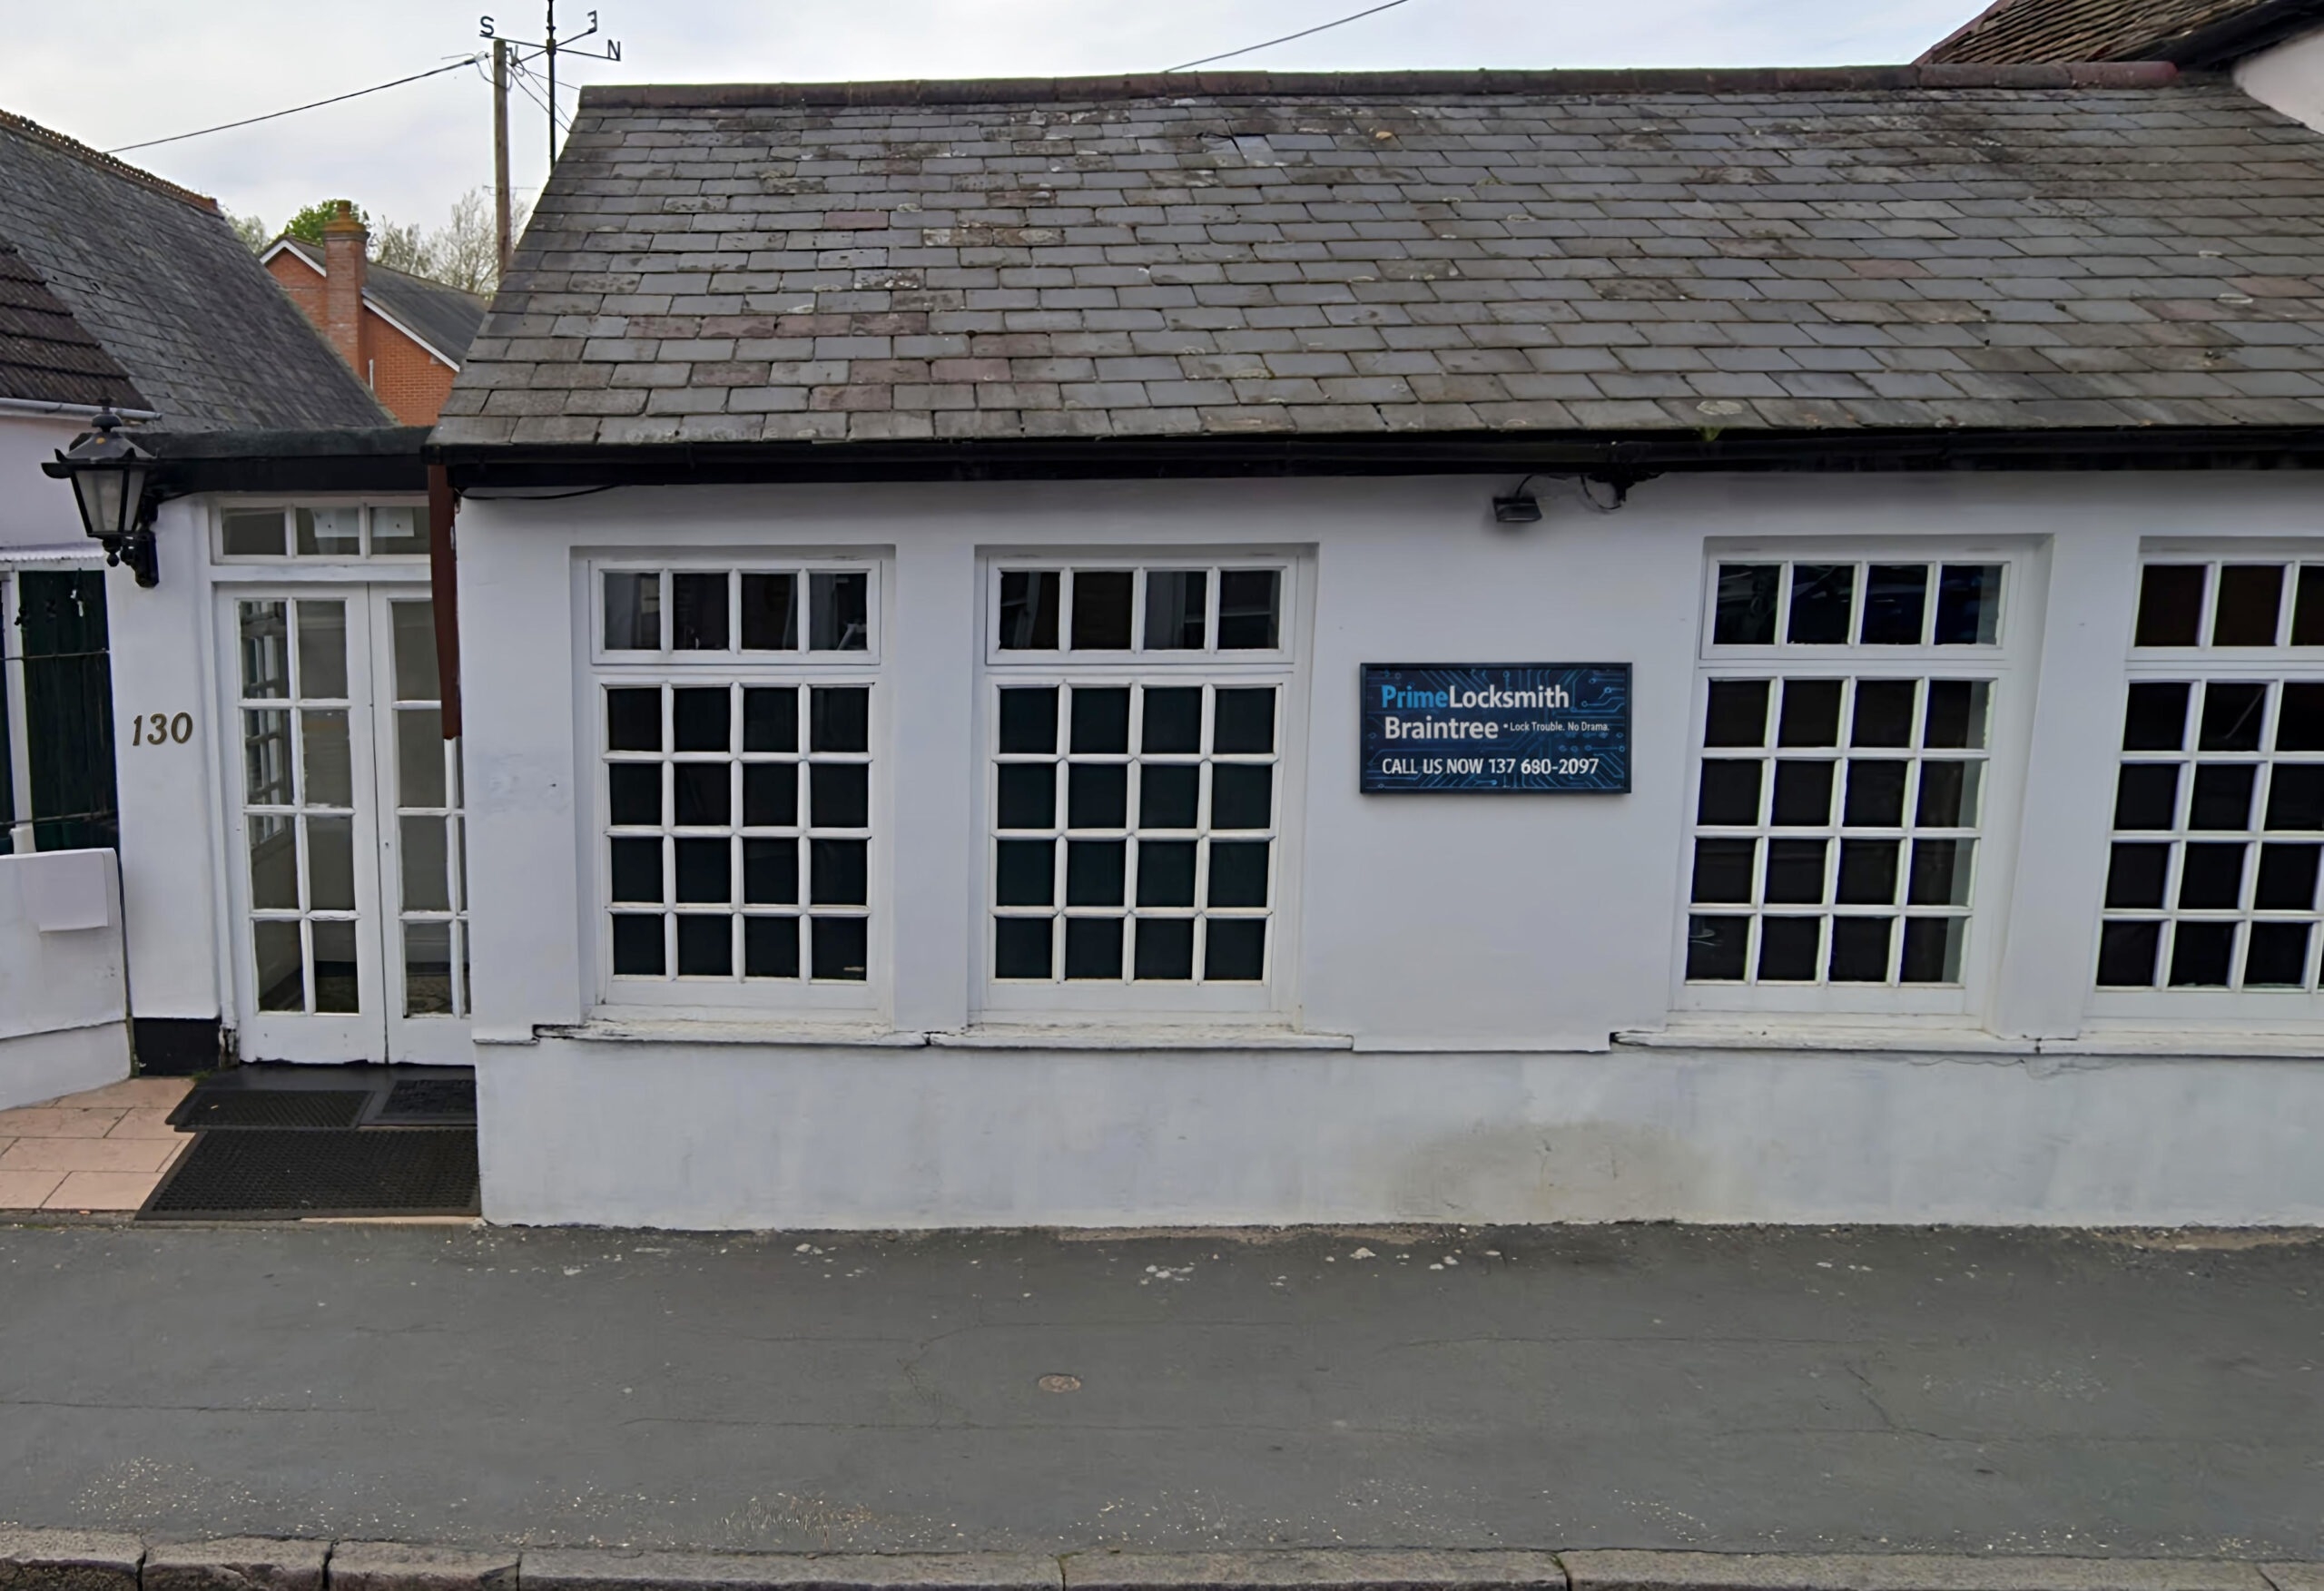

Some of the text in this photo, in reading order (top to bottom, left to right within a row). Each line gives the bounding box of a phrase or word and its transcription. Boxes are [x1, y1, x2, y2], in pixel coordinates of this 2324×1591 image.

[480, 15, 495, 36] S
[607, 39, 621, 61] N
[133, 712, 193, 747] 130
[1384, 715, 1499, 740] Braintree
[1510, 721, 1610, 732] Lock Trouble. No Drama.
[1382, 758, 1600, 775] CALL US NOW 137 680-2097
